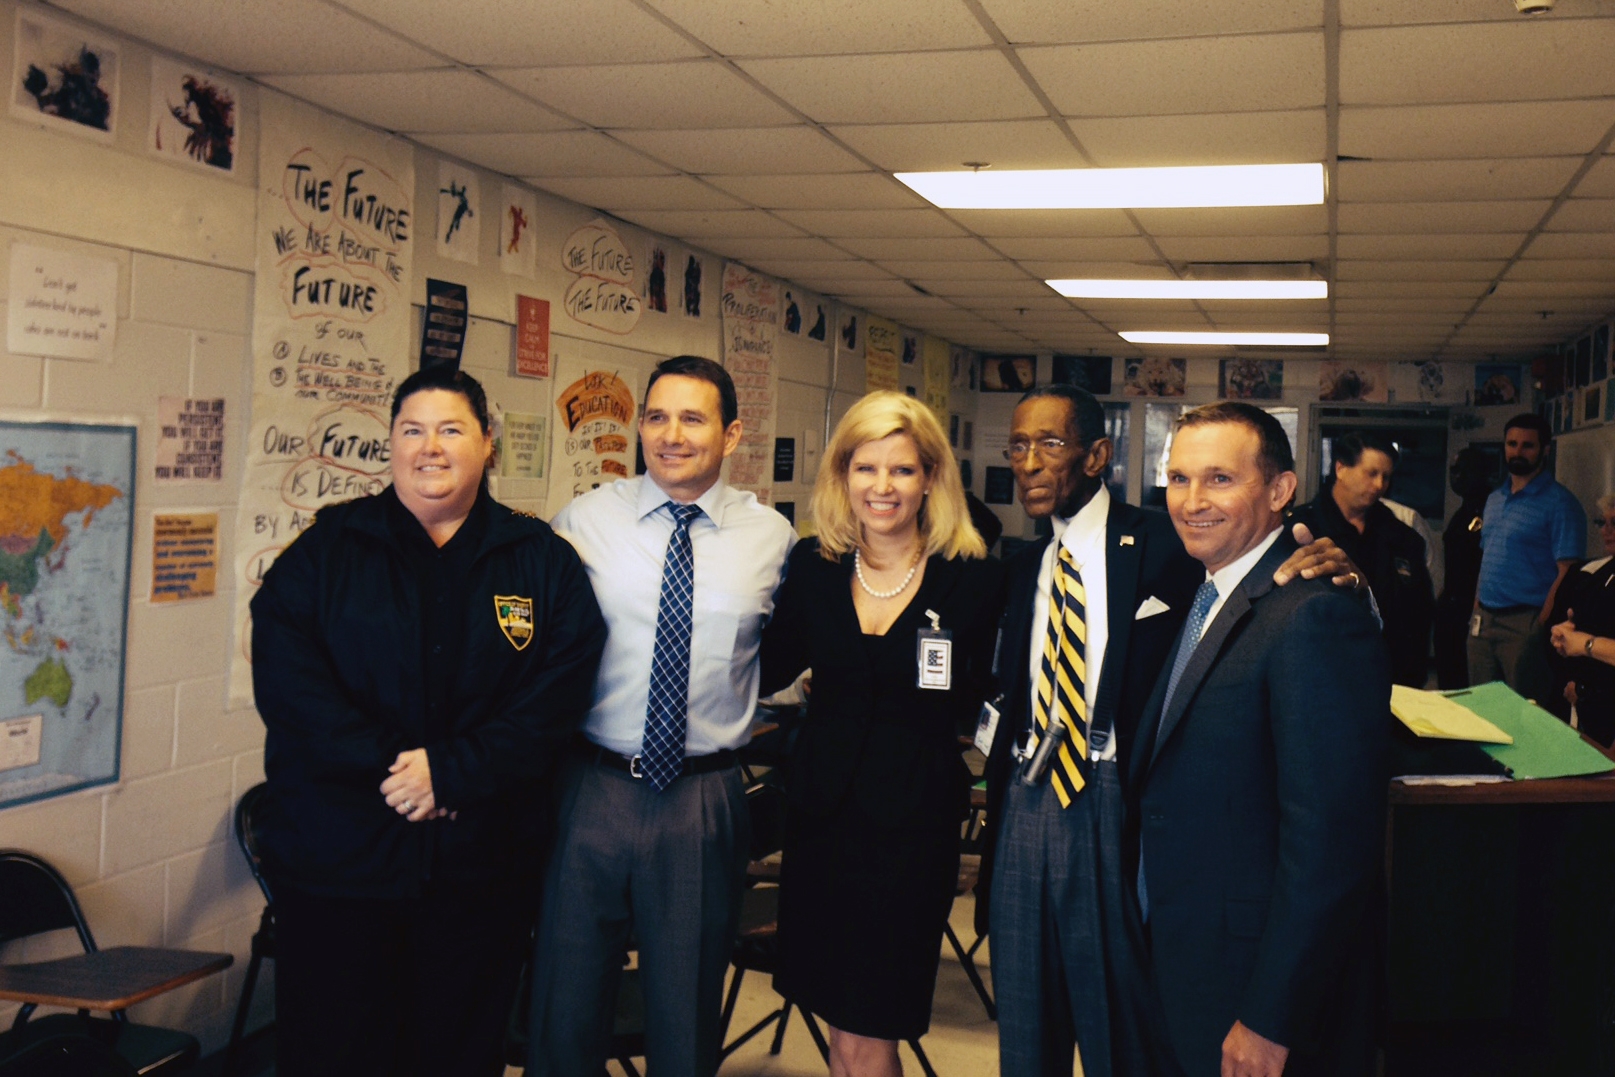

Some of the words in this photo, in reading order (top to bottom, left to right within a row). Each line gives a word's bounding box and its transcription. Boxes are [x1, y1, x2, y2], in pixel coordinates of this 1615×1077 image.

[287, 163, 333, 212] THE
[343, 169, 411, 245] FUTURE
[273, 226, 298, 255] WE
[306, 222, 331, 254] ARE
[338, 231, 380, 264] ABOUT
[386, 251, 404, 283] THE
[568, 246, 588, 268] THE
[591, 235, 634, 276] FUTURE
[292, 266, 377, 315] FUTURE
[569, 288, 592, 317] THE
[595, 282, 639, 315] FUTURE
[298, 346, 341, 367] LIVES
[314, 371, 341, 388] WELL
[195, 400, 209, 412] YOU
[566, 394, 627, 433] EDUCATION
[162, 426, 177, 438] YOU
[194, 440, 207, 451] YOU
[264, 425, 305, 456] OUR
[319, 422, 391, 463] FUTURE
[155, 467, 170, 479] YOU
[292, 470, 310, 497] IS
[254, 514, 280, 540] BY
